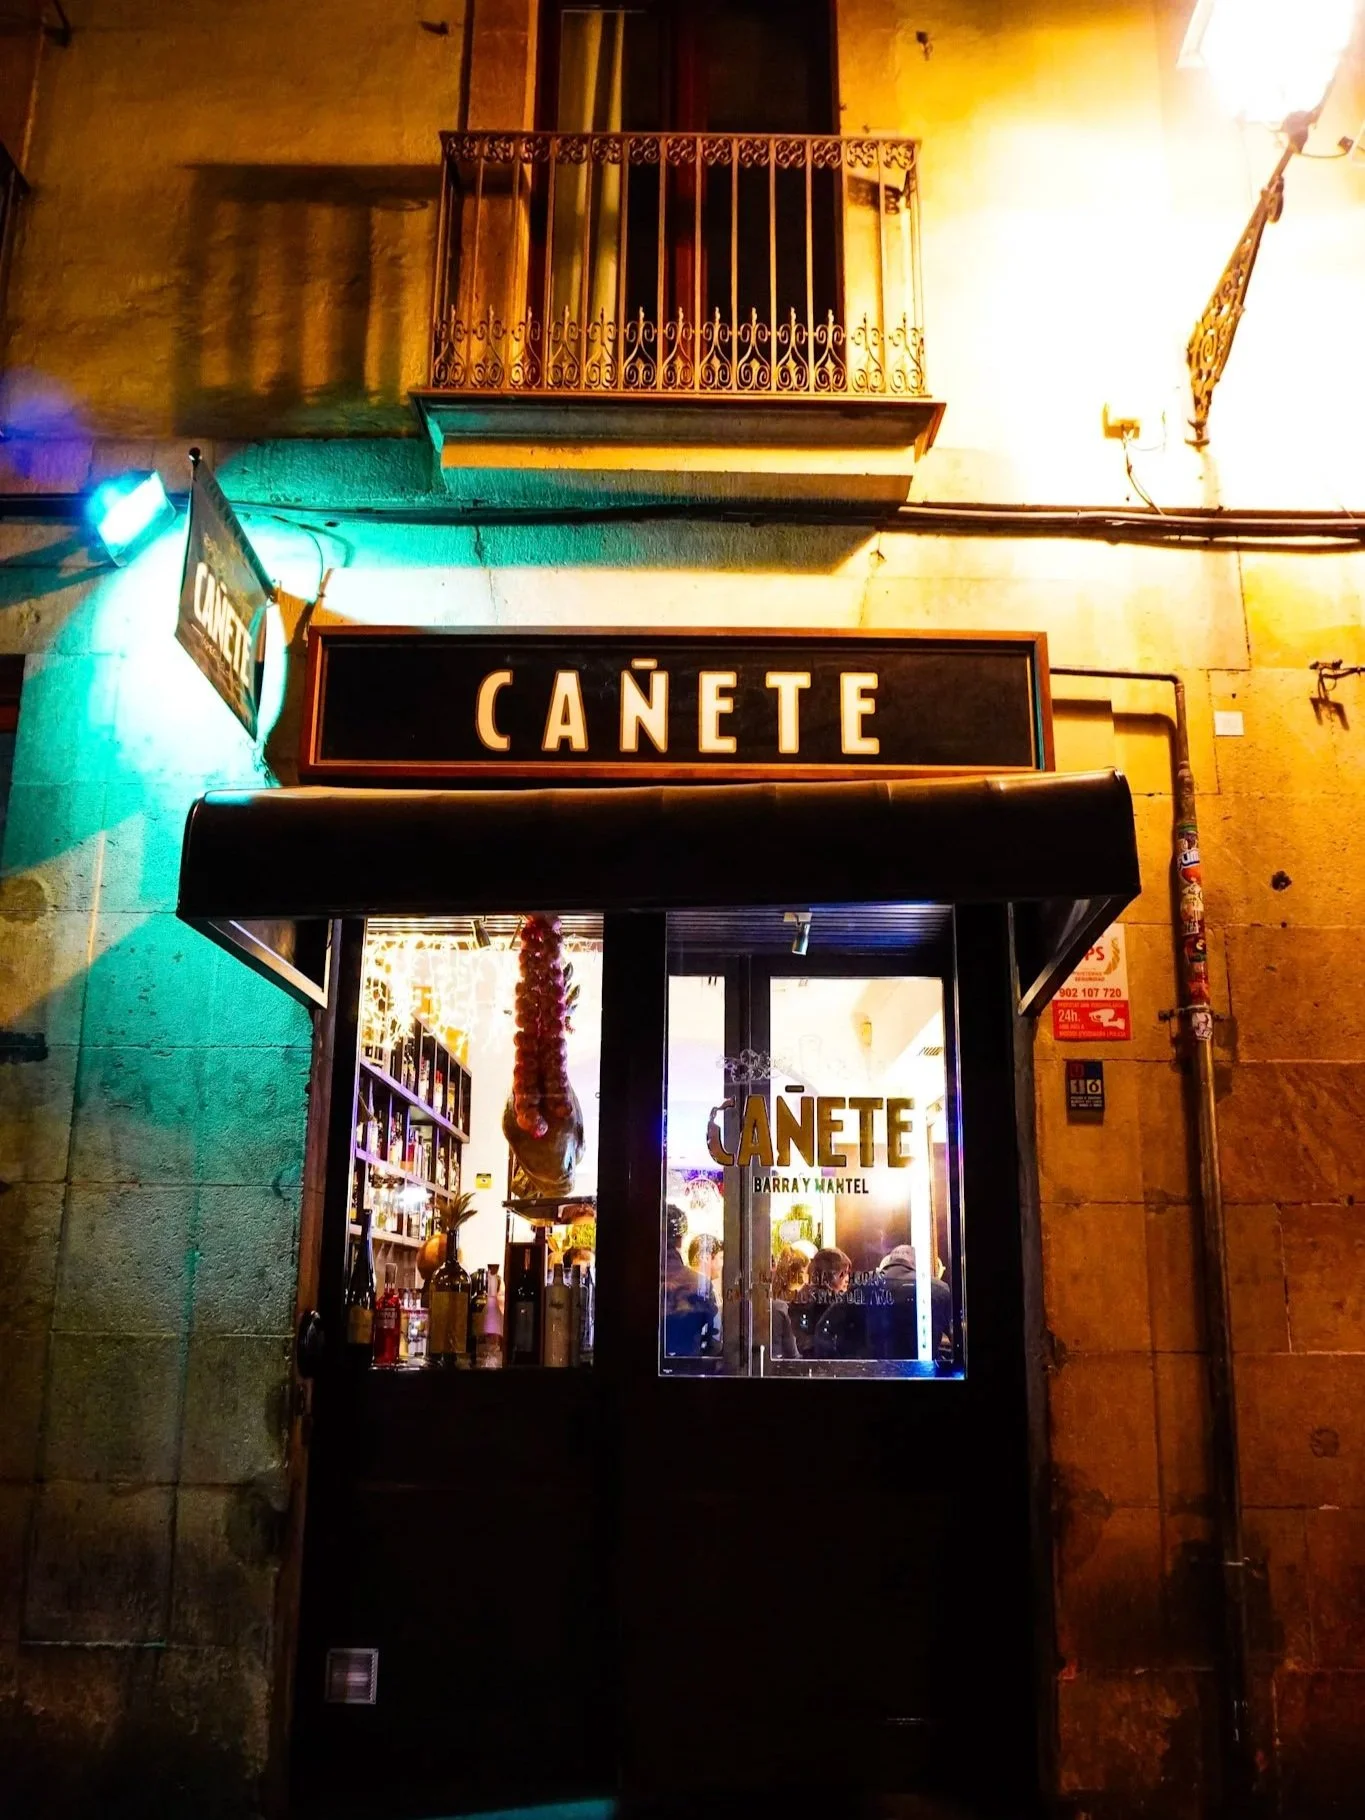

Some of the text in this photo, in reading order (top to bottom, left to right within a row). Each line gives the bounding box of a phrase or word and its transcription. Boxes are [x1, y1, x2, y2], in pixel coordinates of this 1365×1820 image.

[193, 562, 252, 688] CAÑETE
[475, 658, 880, 754] CAÑETE
[1059, 988, 1122, 998] 902 107 720
[706, 1085, 915, 1168] CAÑETE
[753, 1177, 869, 1194] BARRA Y MANTEL
